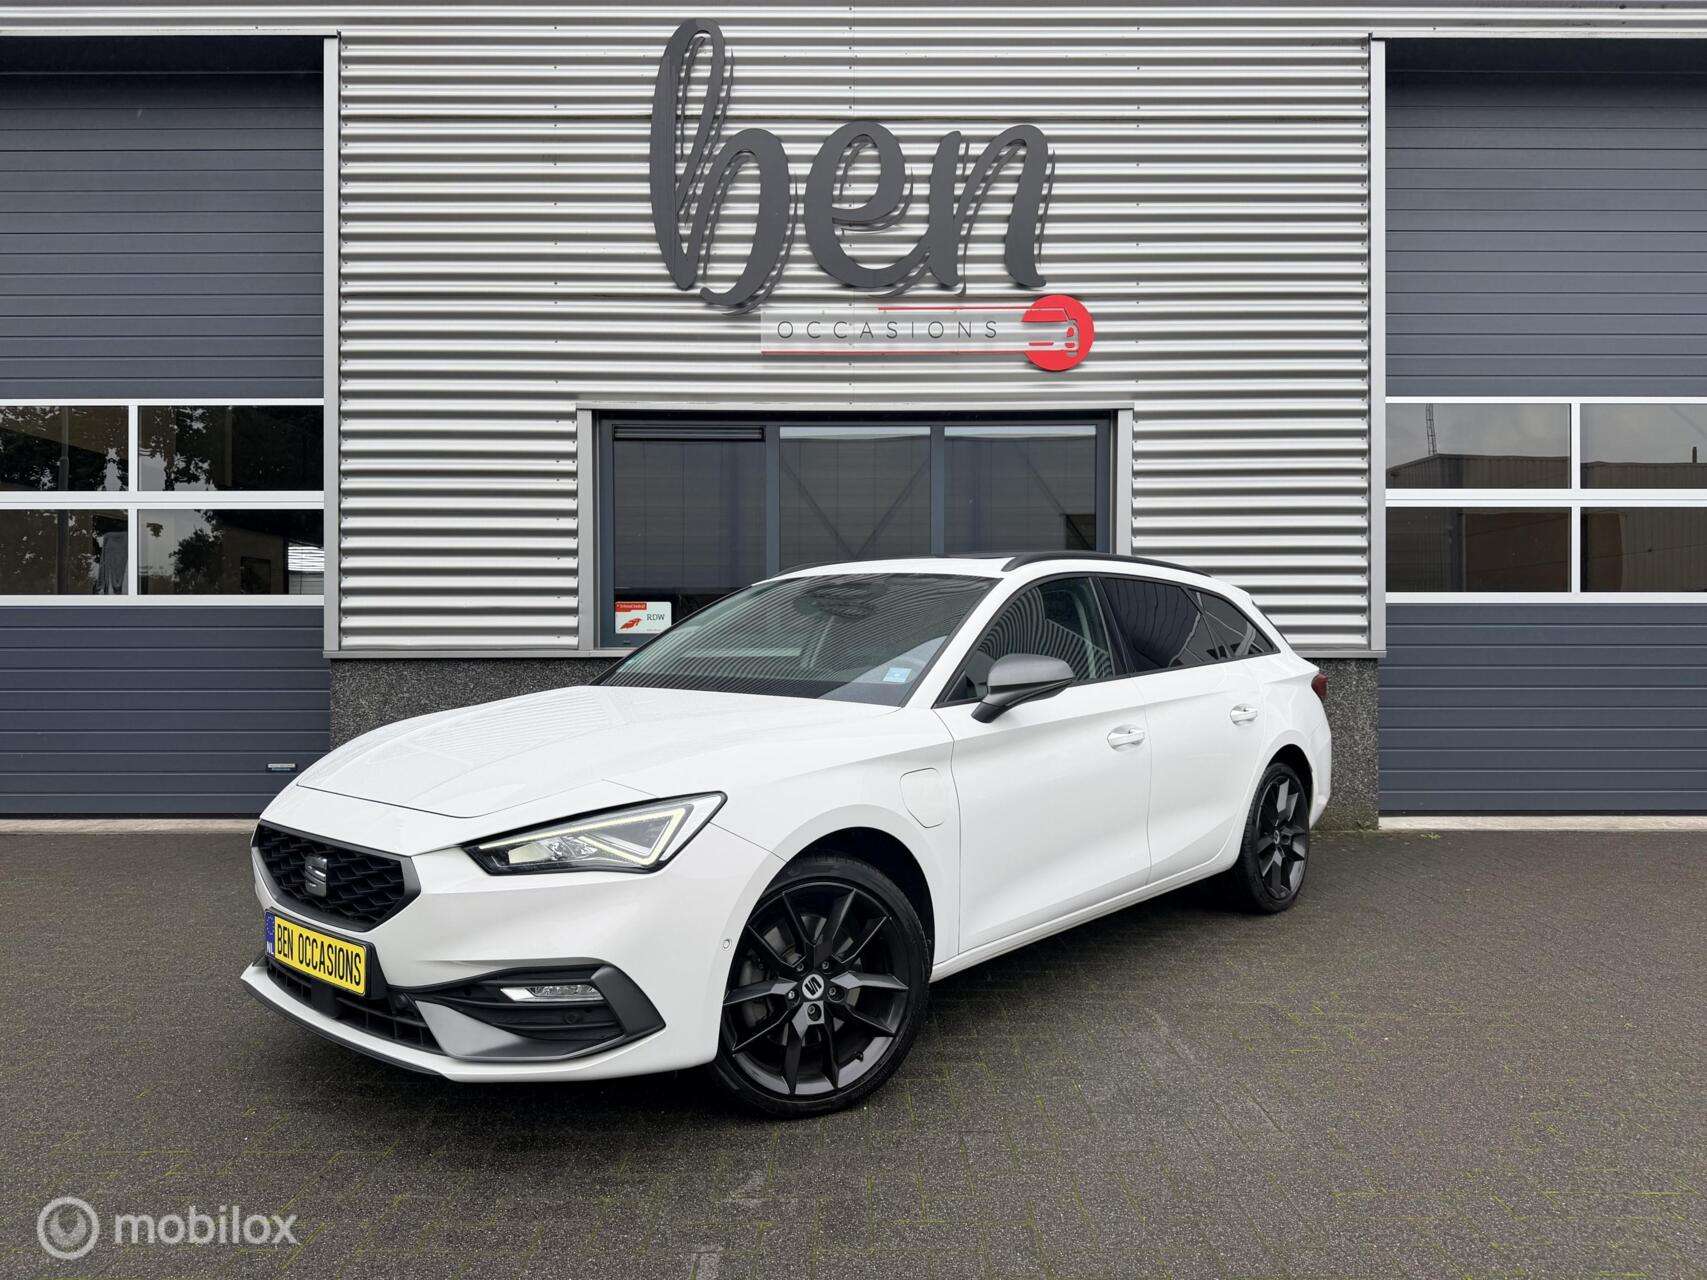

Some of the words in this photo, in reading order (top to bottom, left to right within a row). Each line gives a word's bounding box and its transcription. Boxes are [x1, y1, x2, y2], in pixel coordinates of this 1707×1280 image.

[649, 18, 1048, 305] ben
[776, 320, 998, 339] OCCASIONS
[646, 613, 665, 621] RDW
[266, 942, 275, 955] NL
[277, 923, 294, 961] BEN
[298, 933, 362, 987] OCCASIONS
